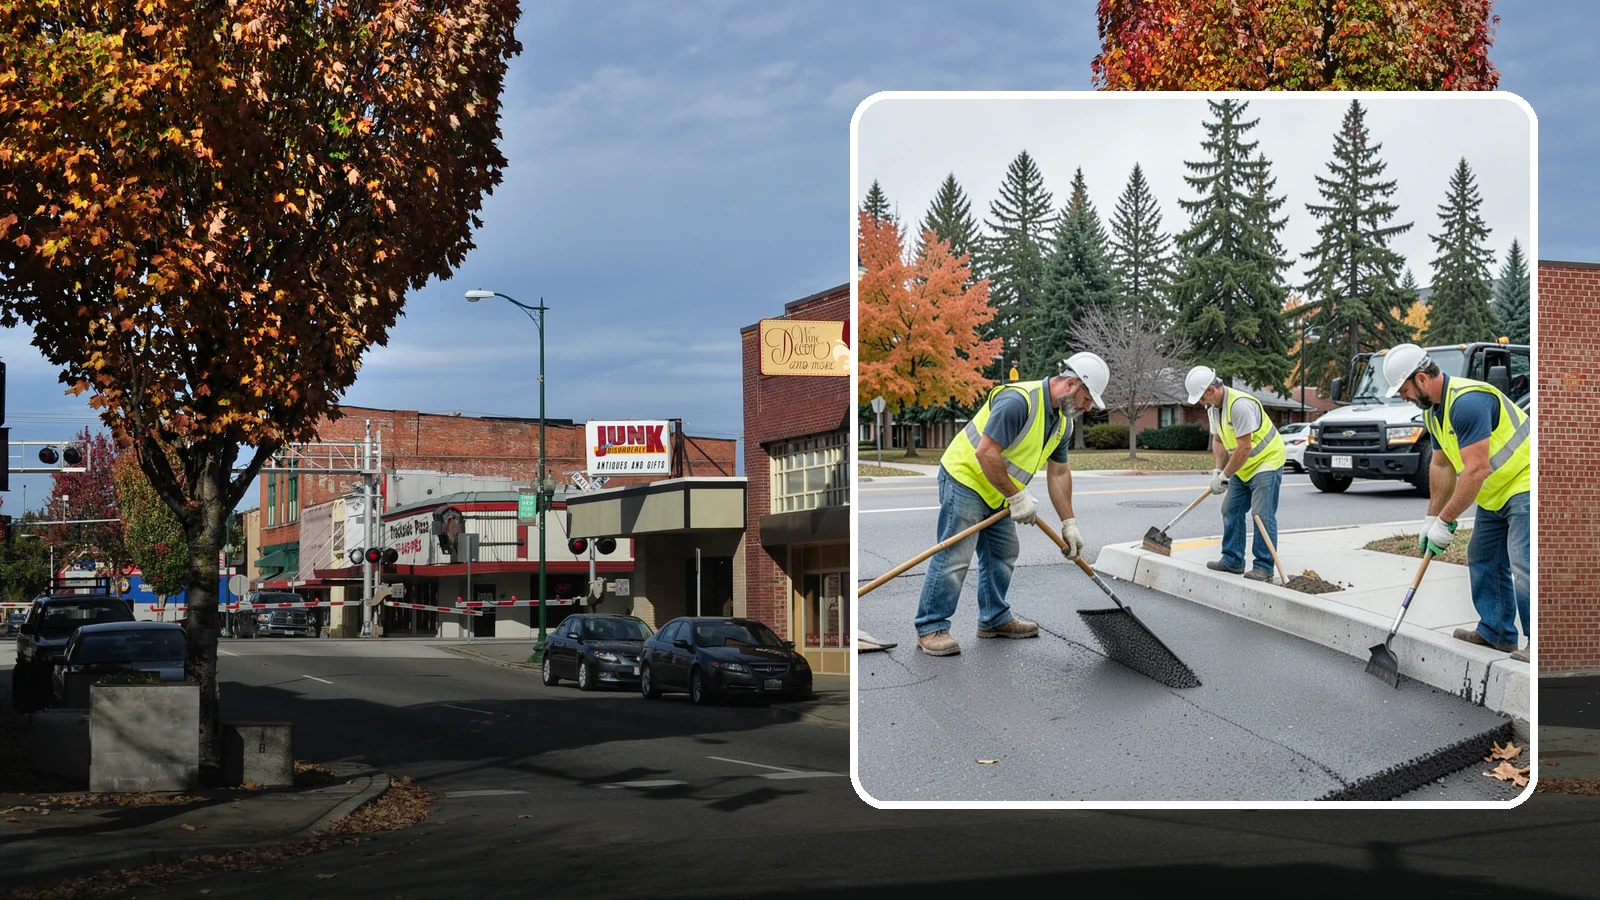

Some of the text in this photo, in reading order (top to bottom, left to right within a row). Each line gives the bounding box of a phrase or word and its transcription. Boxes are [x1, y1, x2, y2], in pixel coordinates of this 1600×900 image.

[595, 425, 665, 457] JUNK
[607, 446, 646, 454] DISORDERLY
[597, 460, 665, 470] ANTIQUES AND GIFTS
